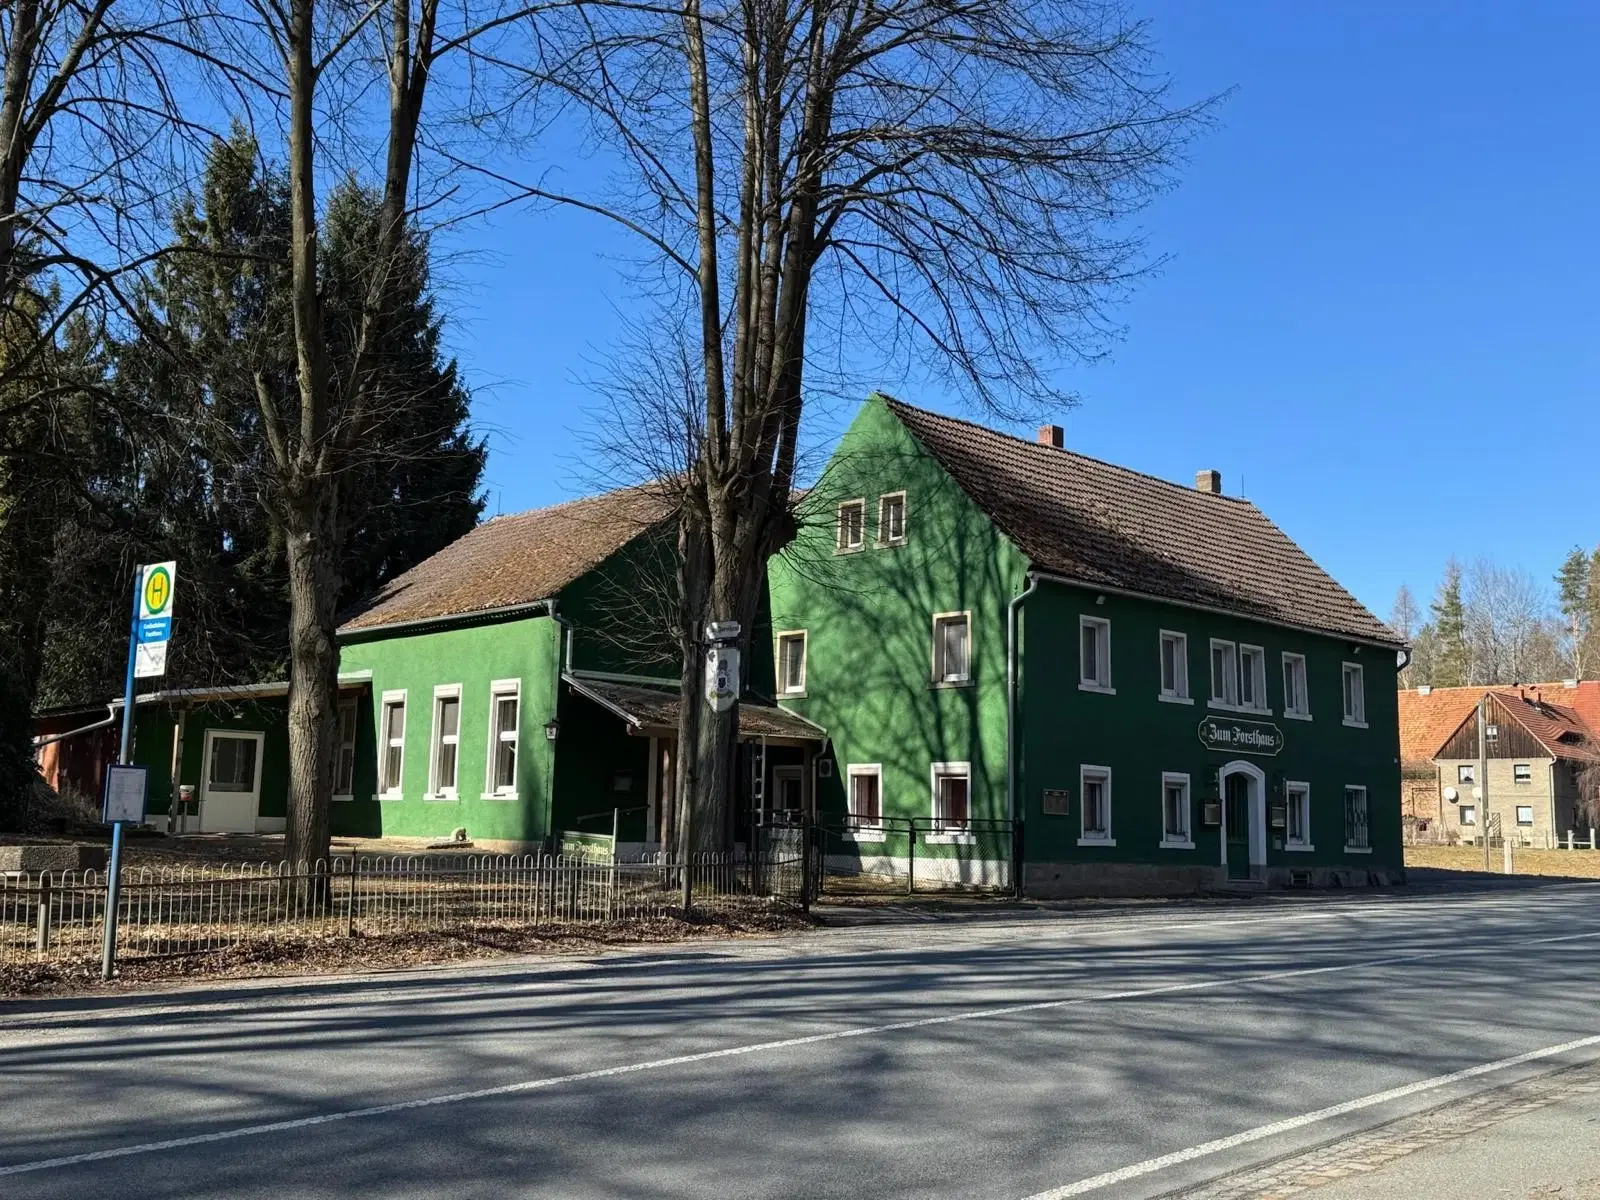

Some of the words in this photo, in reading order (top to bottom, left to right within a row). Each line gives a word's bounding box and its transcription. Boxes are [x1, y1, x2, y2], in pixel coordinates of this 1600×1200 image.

[151, 576, 164, 605] H
[1208, 723, 1231, 743] Zum
[1232, 726, 1275, 748] Forsthaus
